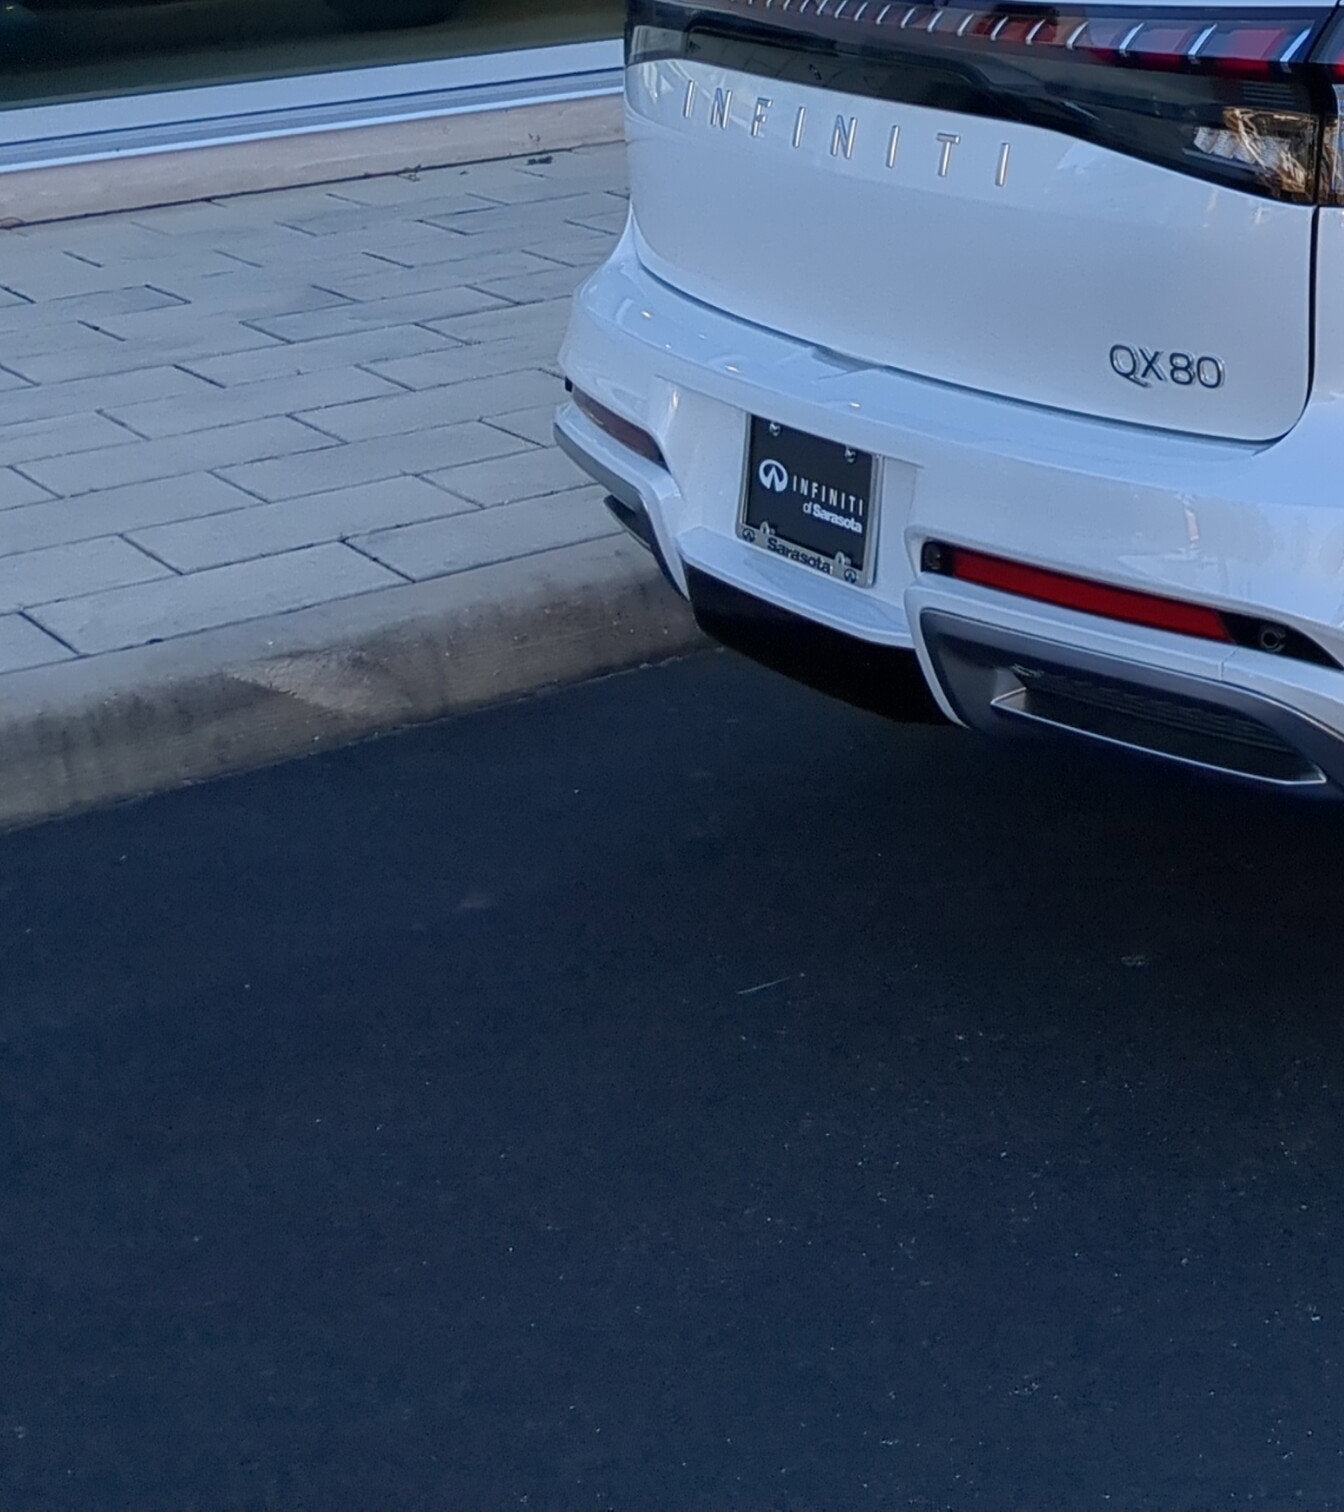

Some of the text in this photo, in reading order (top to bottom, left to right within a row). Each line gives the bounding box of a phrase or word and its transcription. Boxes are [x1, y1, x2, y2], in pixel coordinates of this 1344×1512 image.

[683, 79, 1012, 188] INFINITI
[1109, 344, 1225, 389] QX80
[793, 474, 864, 517] INFINITI
[812, 503, 863, 534] Sarasota
[767, 537, 831, 574] Sarasota
